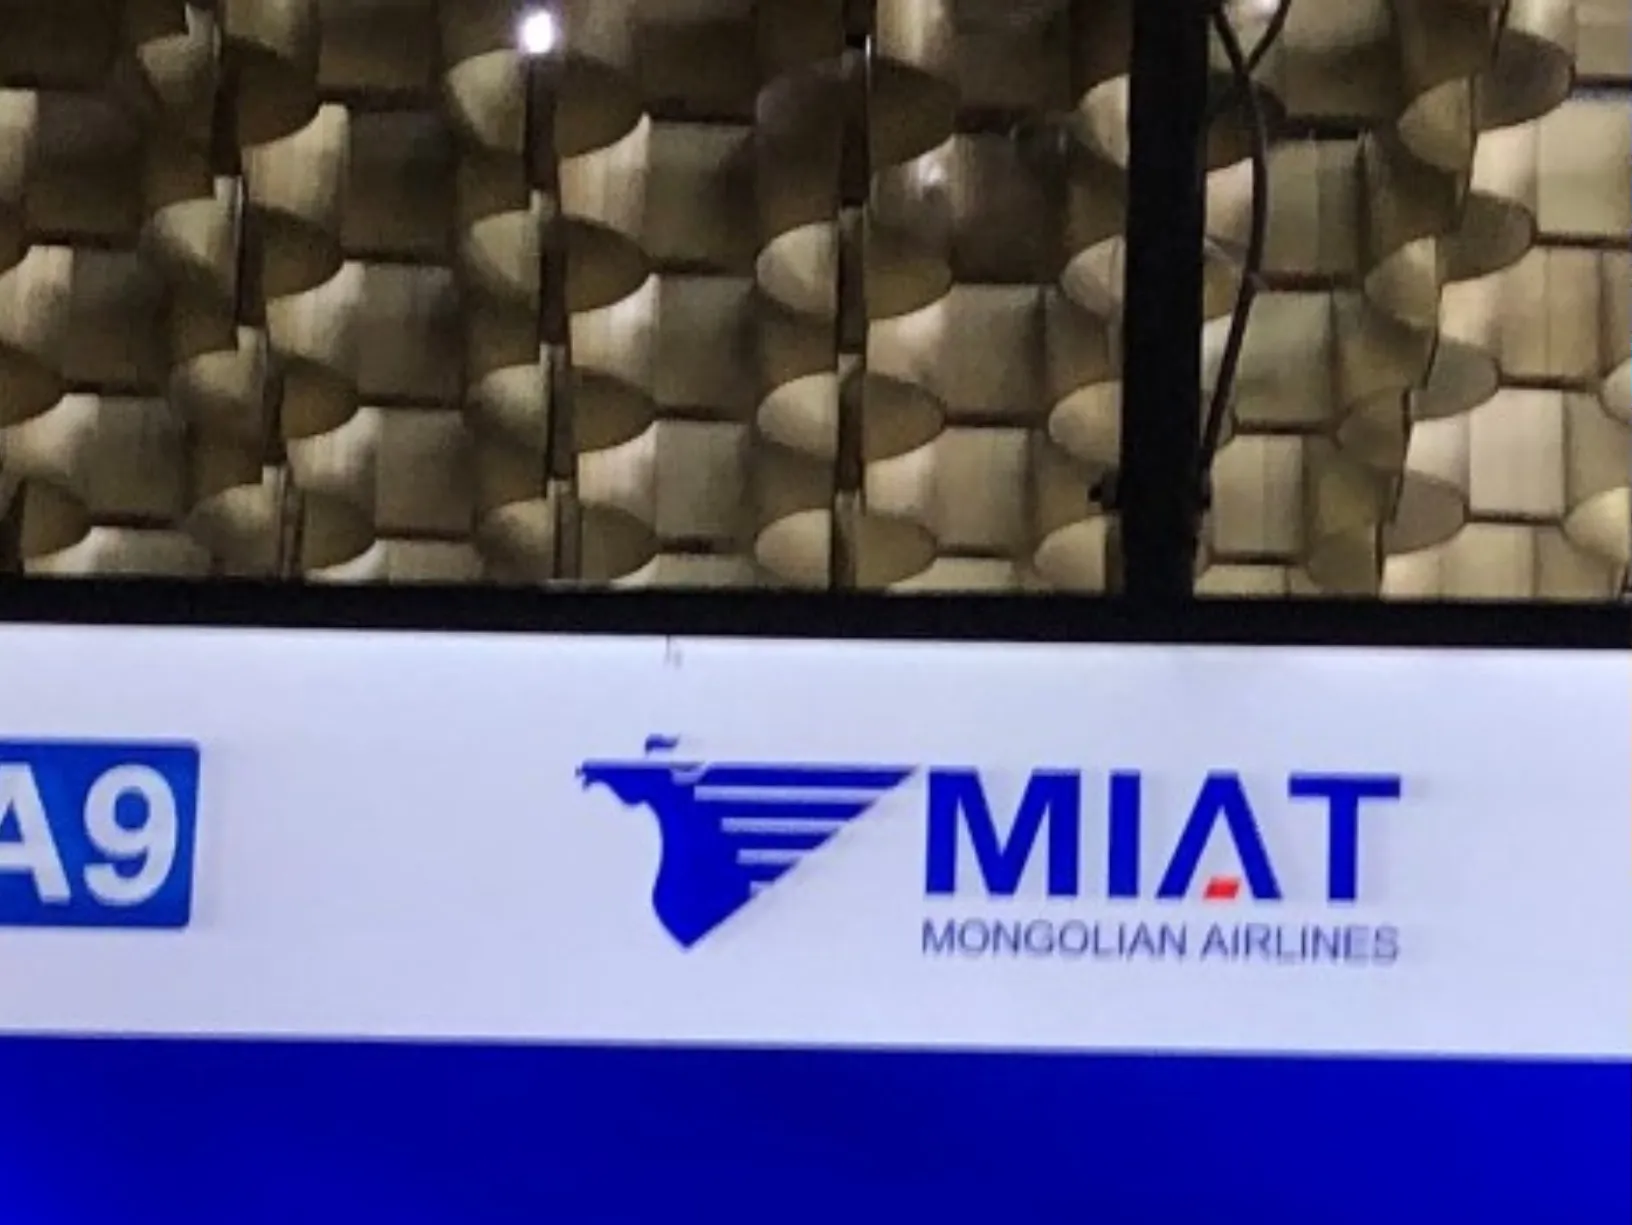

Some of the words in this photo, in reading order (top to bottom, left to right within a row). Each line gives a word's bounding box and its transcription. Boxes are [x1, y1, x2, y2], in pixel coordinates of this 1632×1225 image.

[924, 765, 1402, 903] MIAT
[921, 917, 1188, 959] MONGOLIAN
[1200, 921, 1400, 963] AIRLINES
